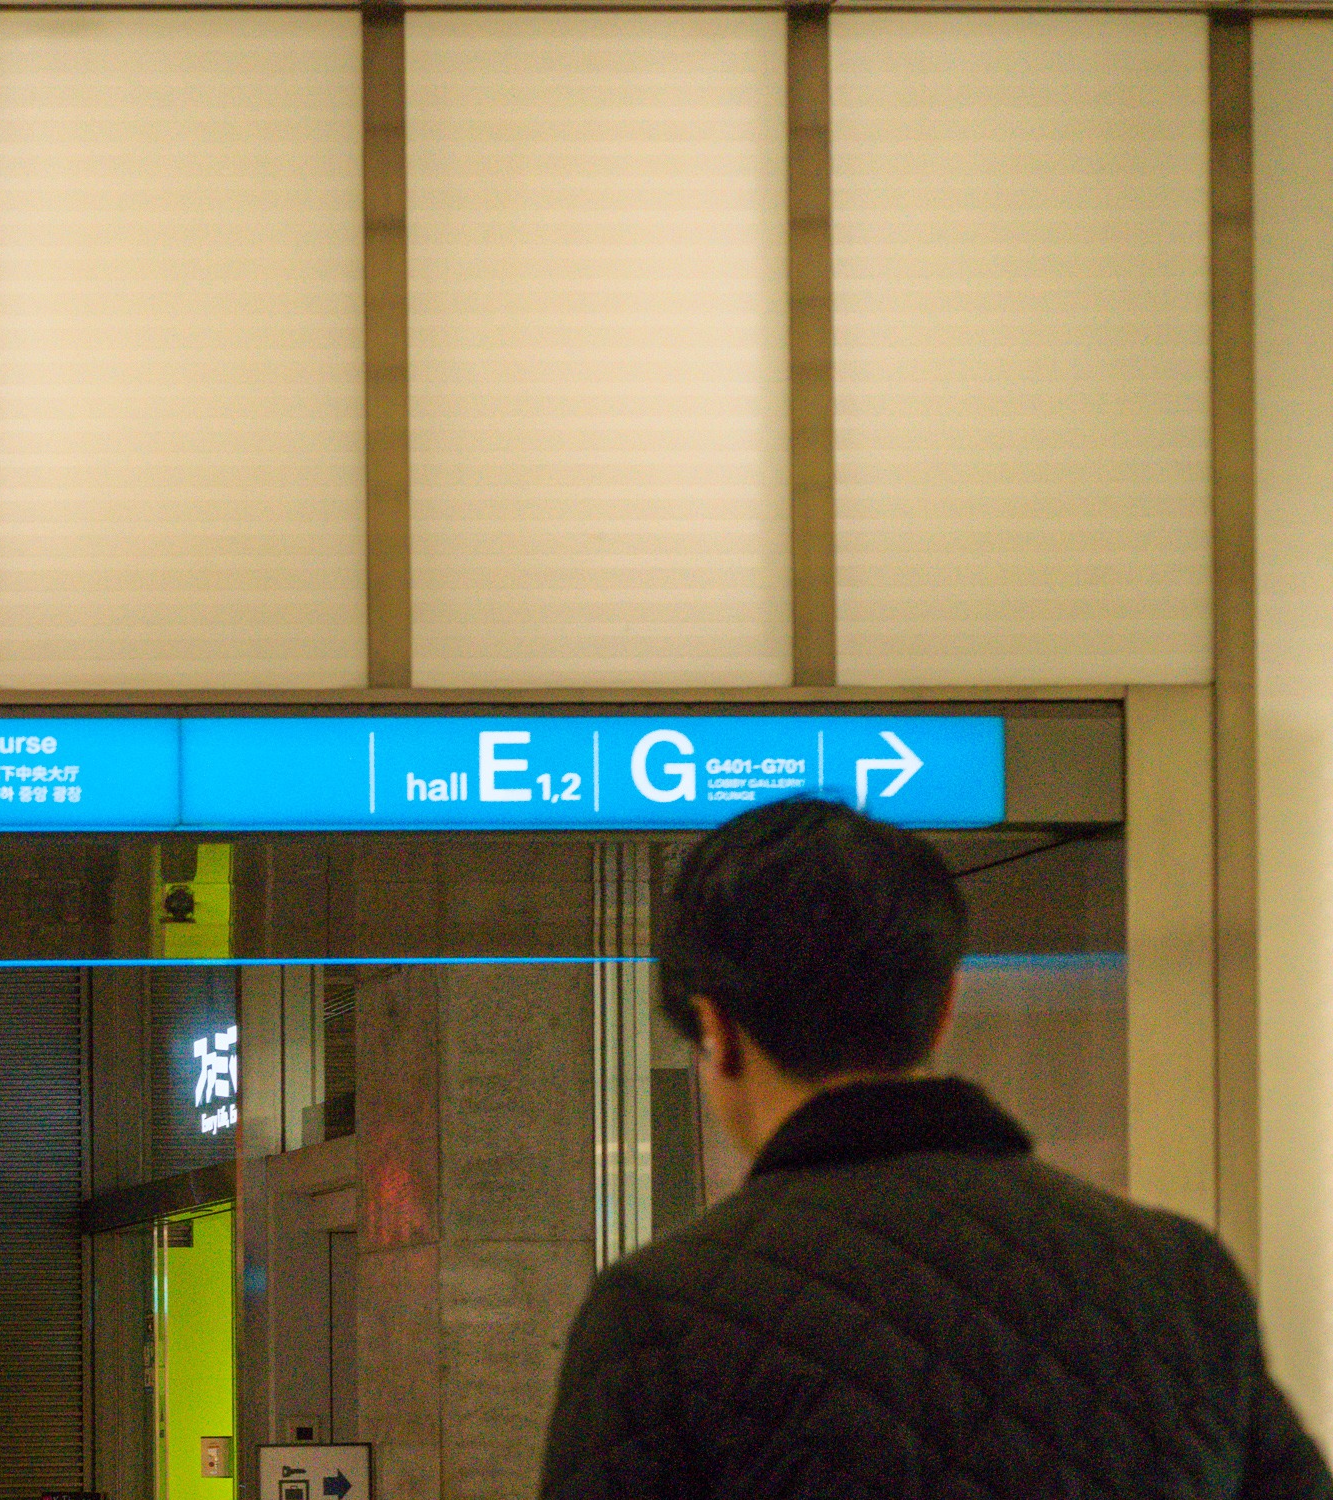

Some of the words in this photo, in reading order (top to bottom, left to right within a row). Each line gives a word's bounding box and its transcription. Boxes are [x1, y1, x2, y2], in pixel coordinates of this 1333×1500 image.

[406, 771, 468, 802] hall
[478, 730, 532, 802] E
[536, 772, 582, 804] 1,2
[630, 728, 696, 803] G
[705, 758, 806, 775] G401-G701
[707, 778, 747, 789] LOBBY
